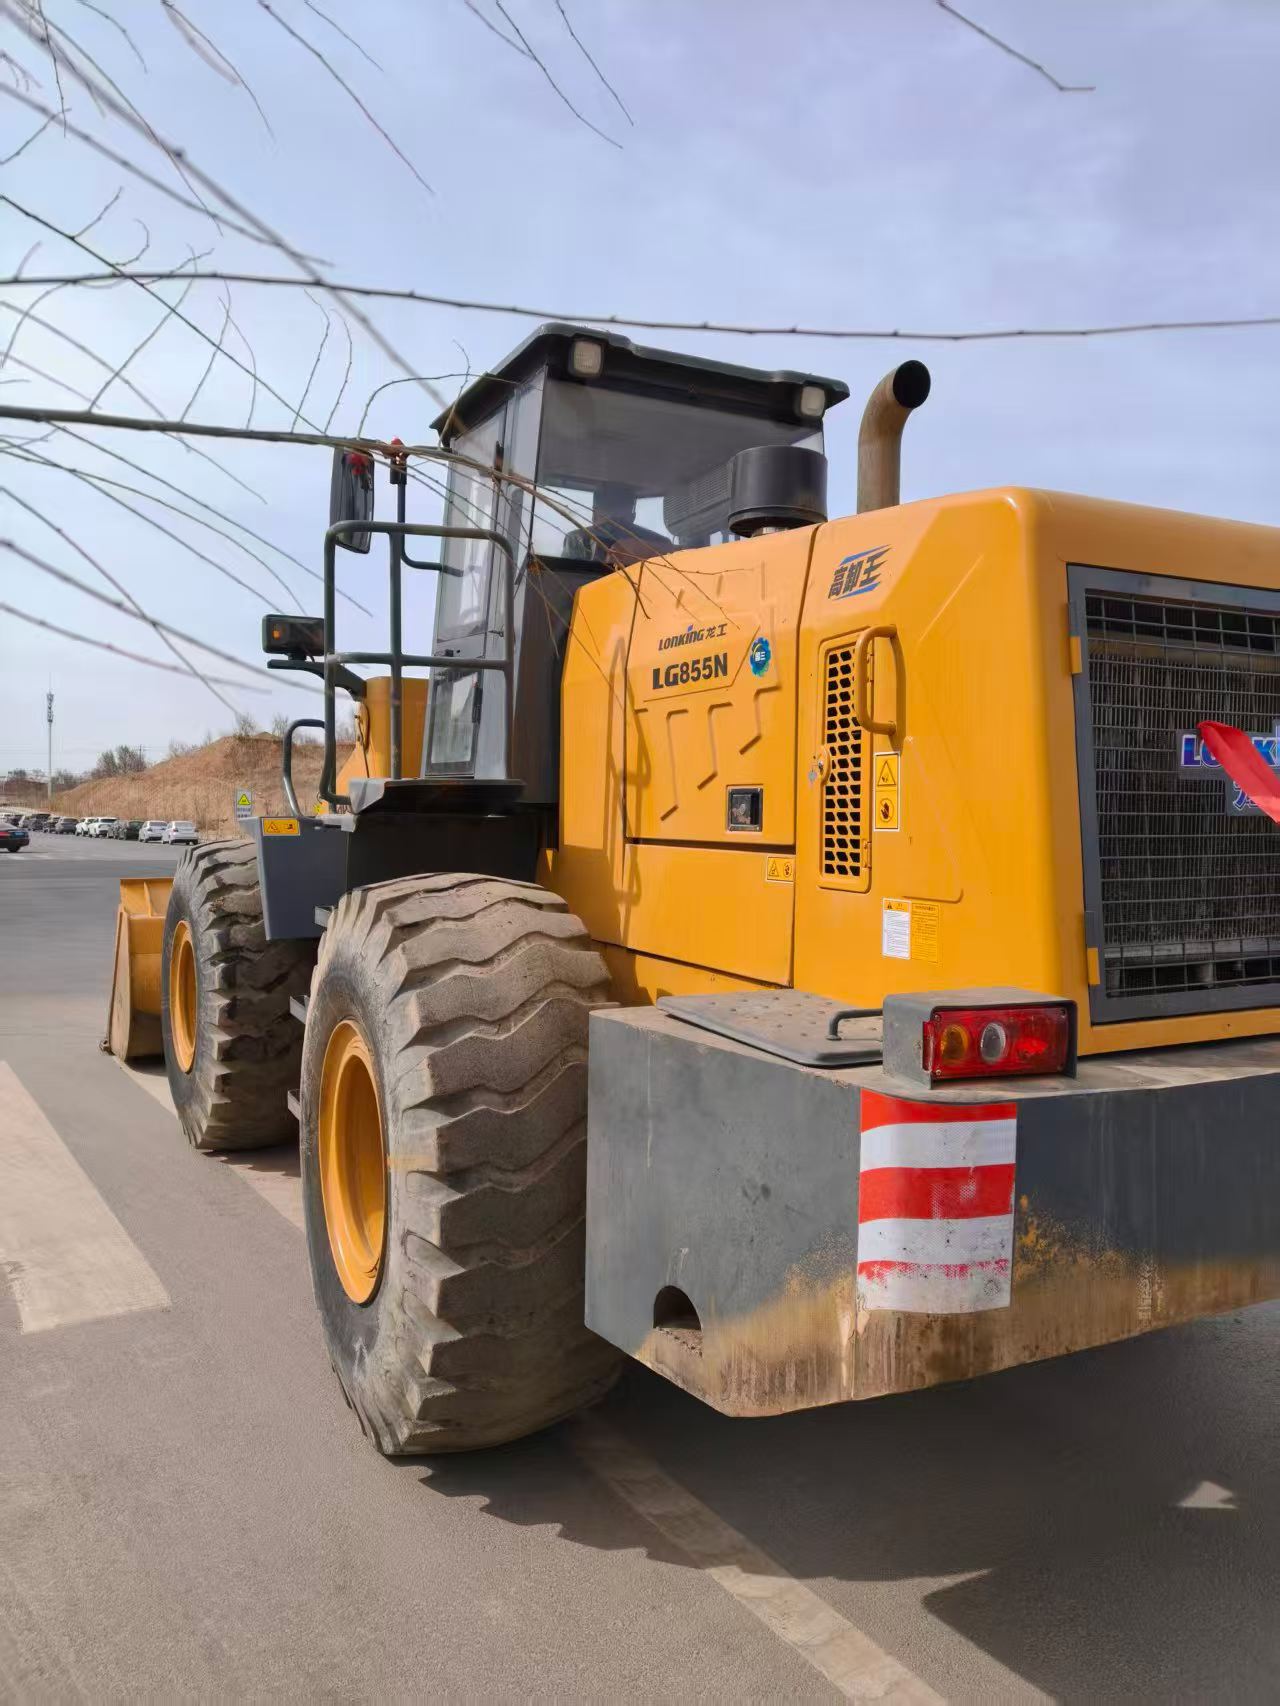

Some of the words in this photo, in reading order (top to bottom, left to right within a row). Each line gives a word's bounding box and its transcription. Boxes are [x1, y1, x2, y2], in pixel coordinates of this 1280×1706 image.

[828, 546, 891, 599] 高卸王
[652, 652, 728, 690] LG855N
